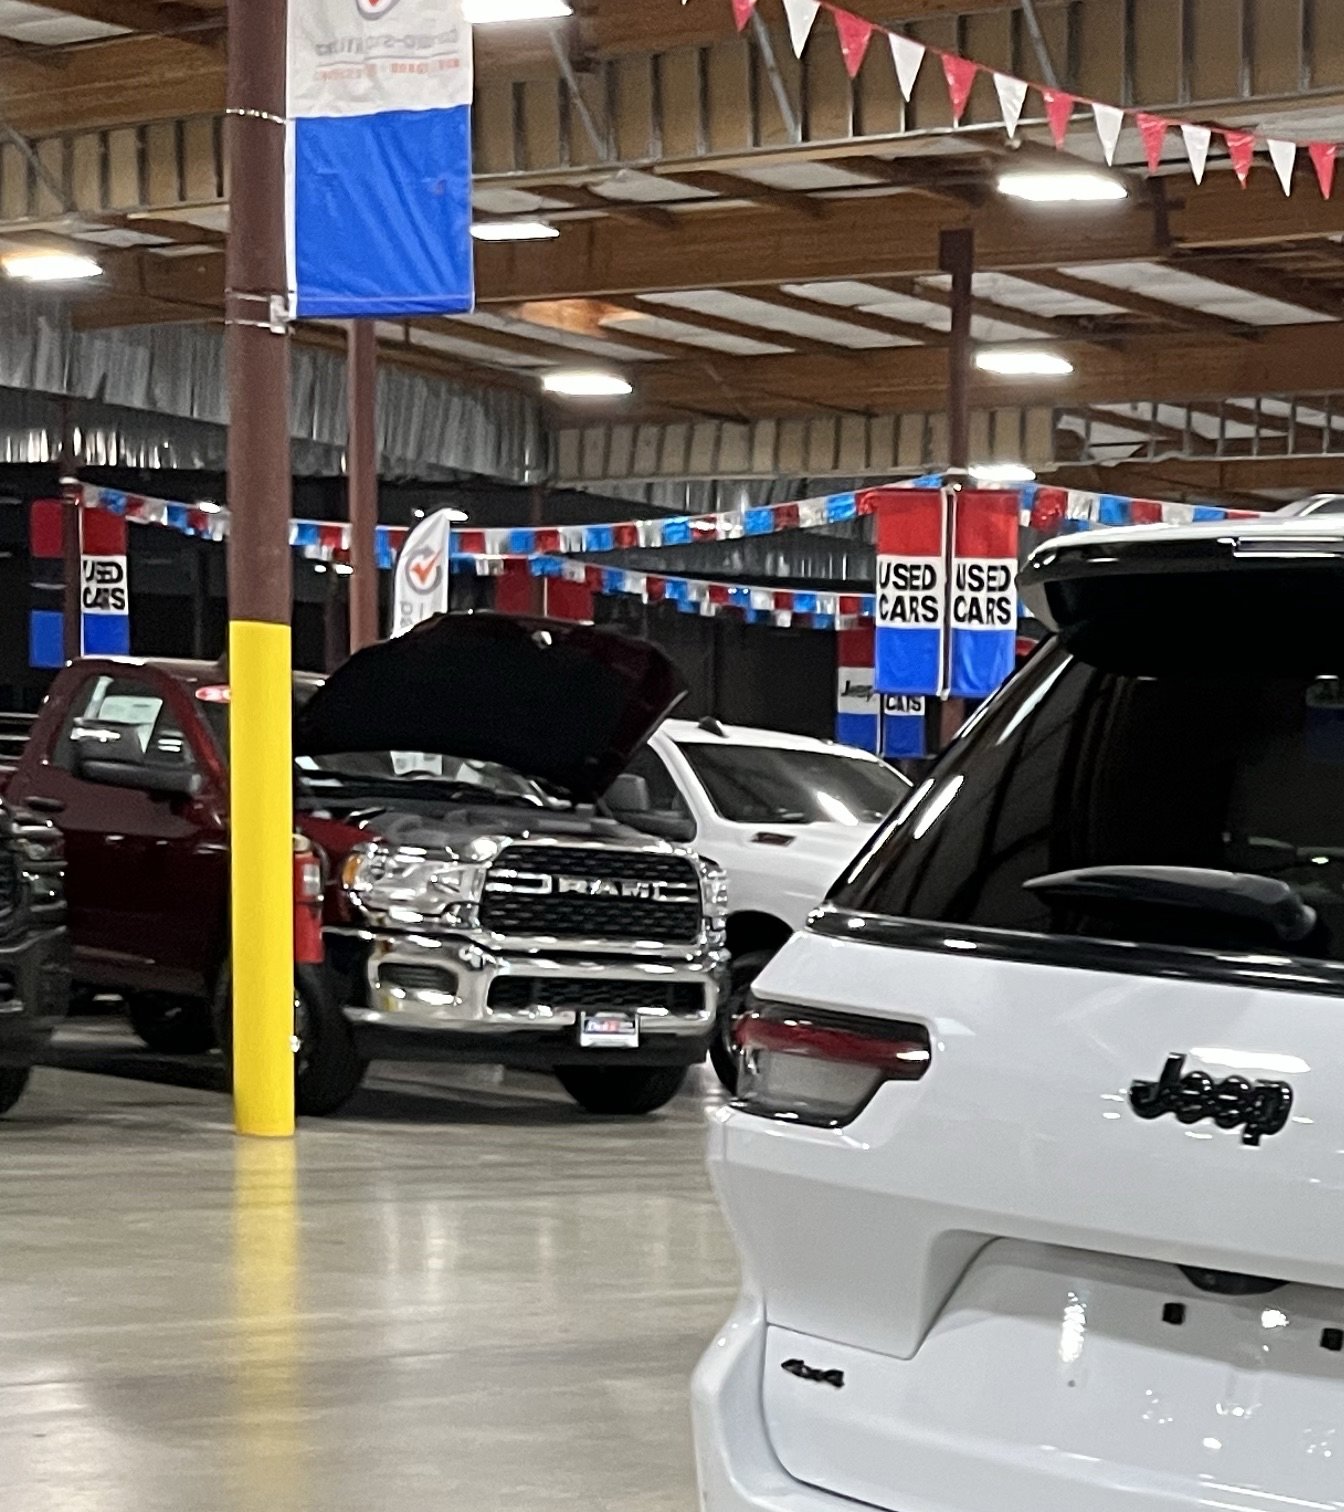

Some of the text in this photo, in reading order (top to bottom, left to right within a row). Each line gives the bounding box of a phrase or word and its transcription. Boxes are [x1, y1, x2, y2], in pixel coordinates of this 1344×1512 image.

[83, 560, 124, 584] UED
[879, 561, 937, 591] USED
[956, 563, 1011, 592] USED
[879, 593, 939, 623] CARS
[953, 595, 1011, 625] CARS
[558, 877, 650, 898] RAM
[1129, 1052, 1294, 1147] Jeep
